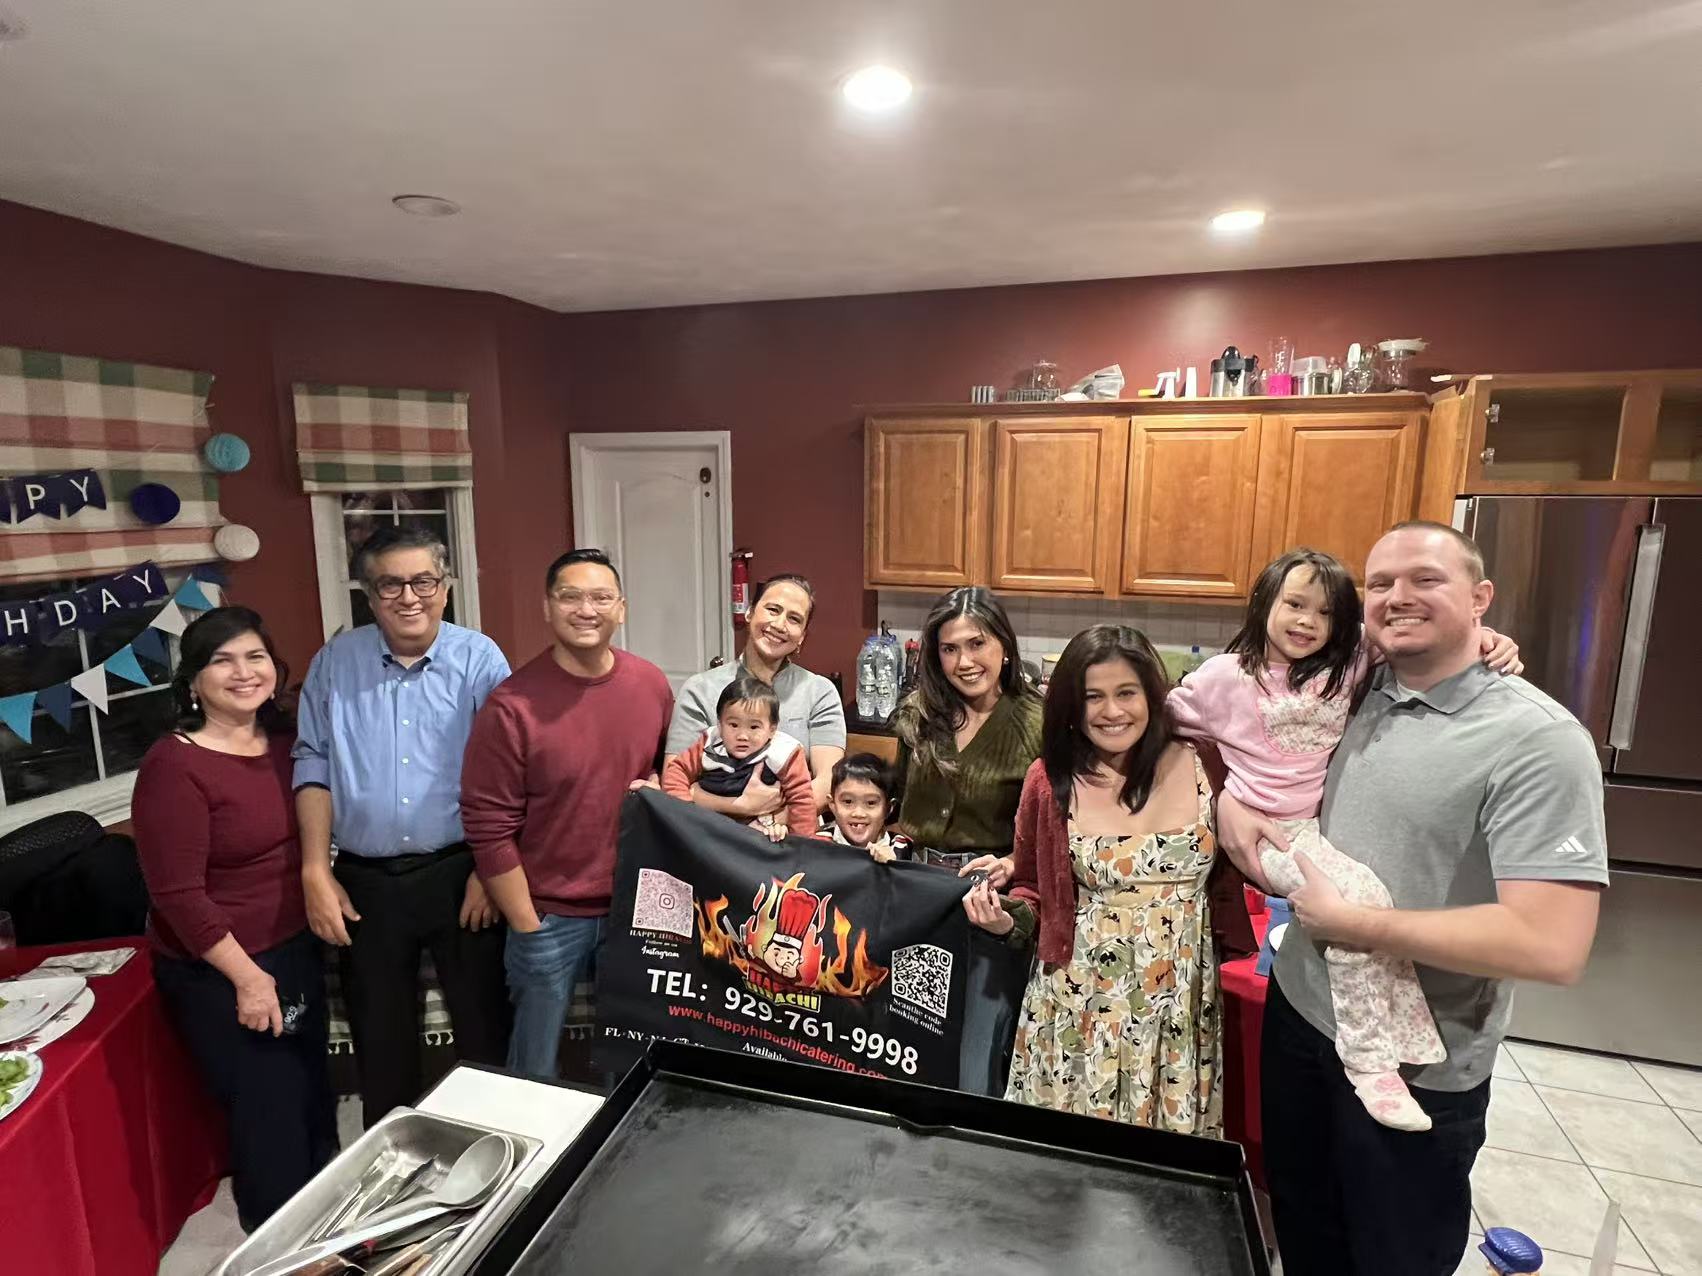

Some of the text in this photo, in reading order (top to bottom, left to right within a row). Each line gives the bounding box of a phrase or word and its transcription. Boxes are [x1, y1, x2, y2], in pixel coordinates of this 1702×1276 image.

[641, 945, 680, 960] Instagram
[647, 968, 919, 1075] TEL: 929-761-9998
